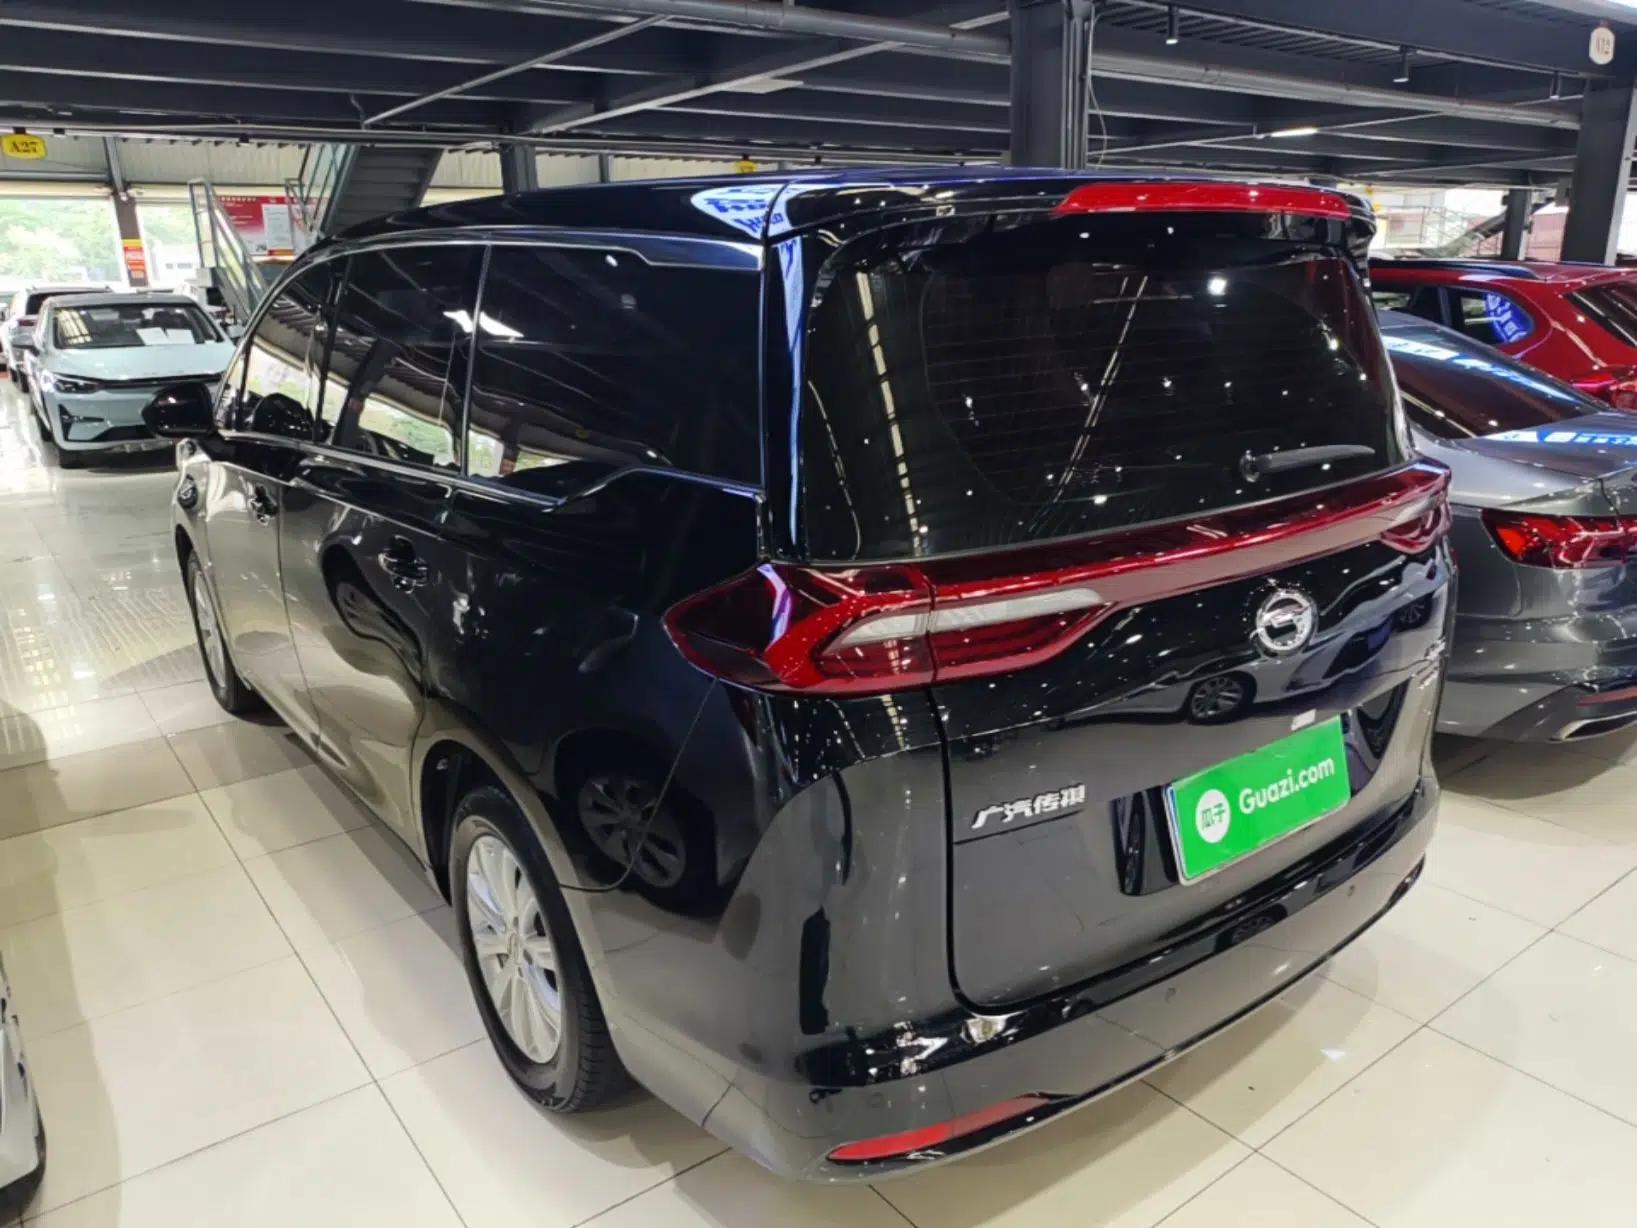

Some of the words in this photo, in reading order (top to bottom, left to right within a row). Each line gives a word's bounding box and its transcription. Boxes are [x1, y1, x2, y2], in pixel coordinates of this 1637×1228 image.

[971, 784, 1086, 829] 广汽传祺
[1238, 757, 1335, 815] Guazi.com
[1201, 802, 1226, 830] 瓜子
